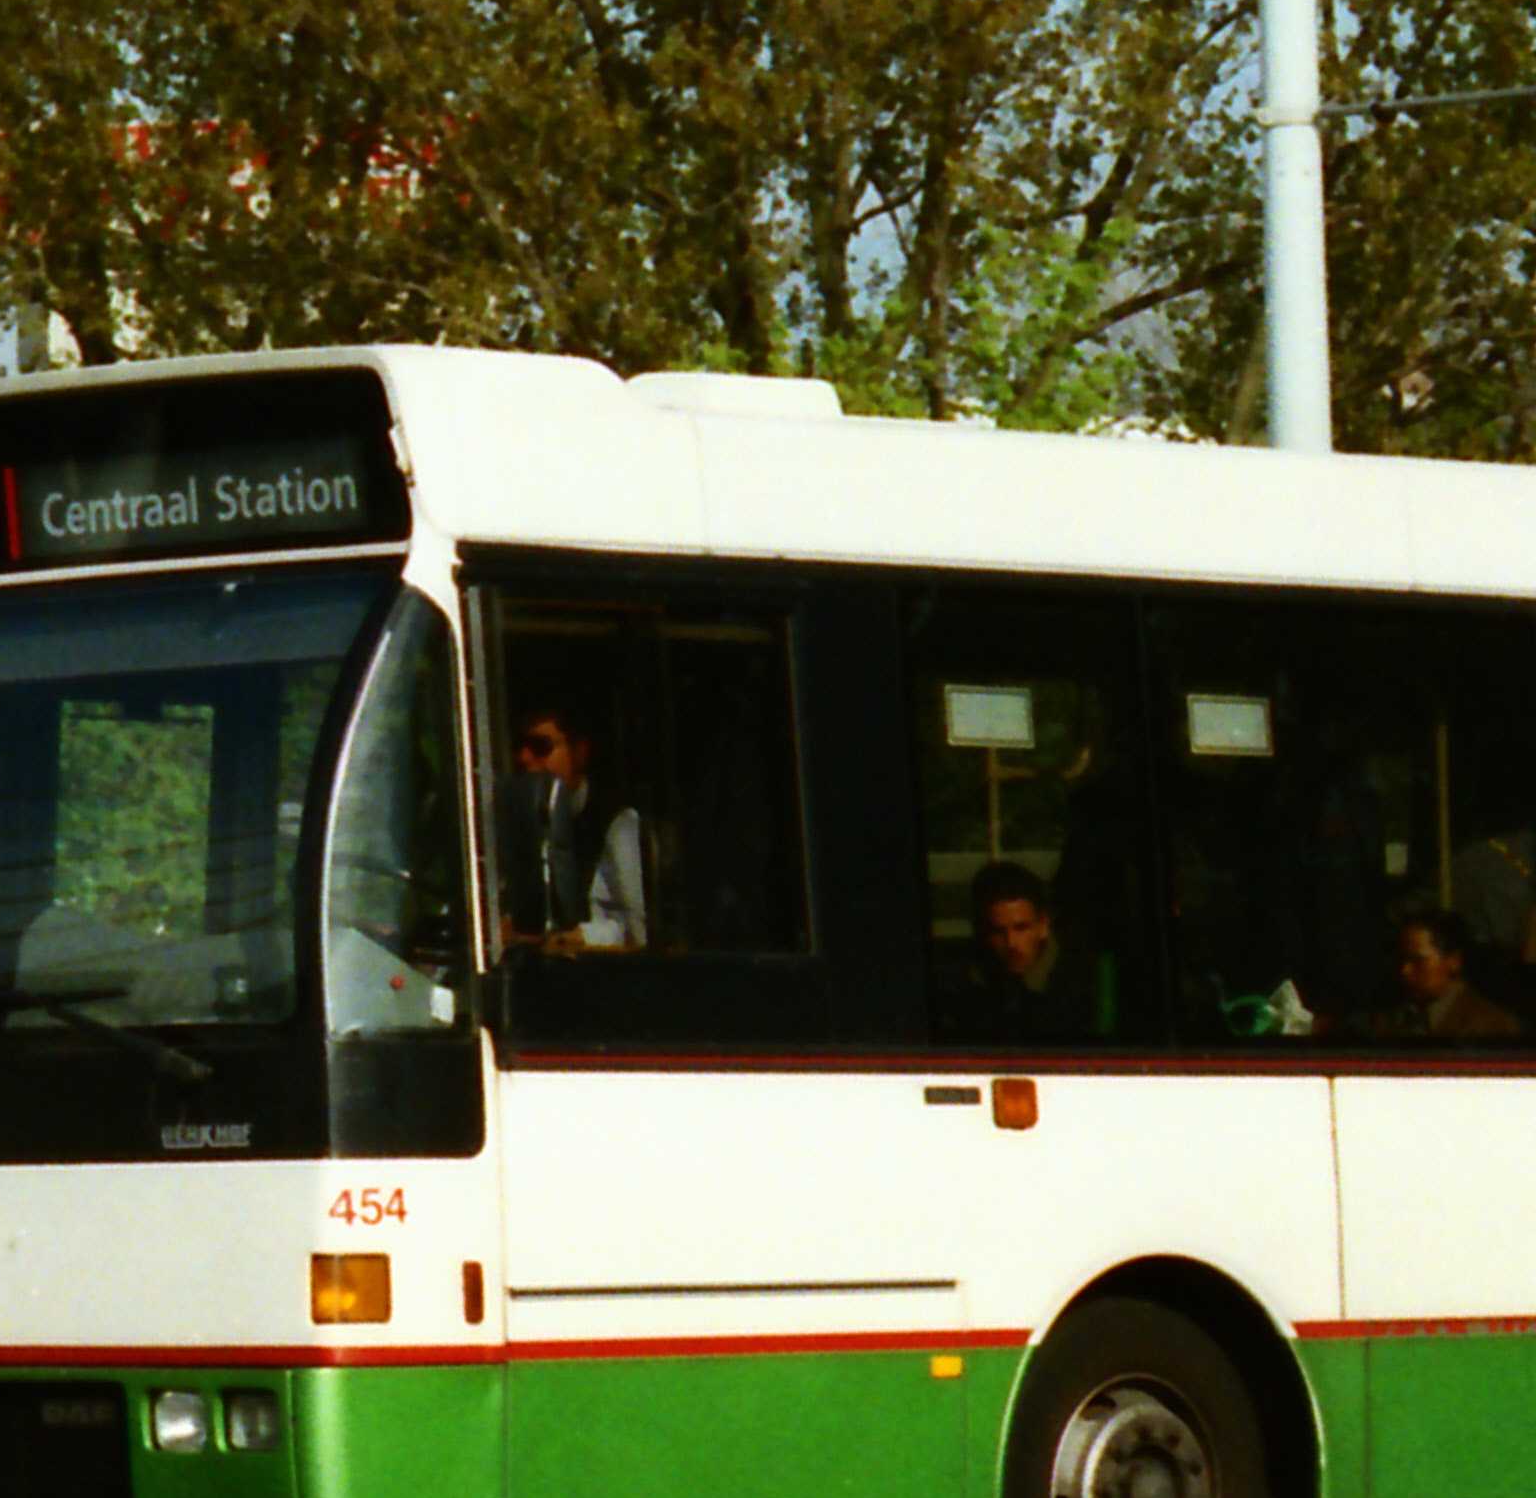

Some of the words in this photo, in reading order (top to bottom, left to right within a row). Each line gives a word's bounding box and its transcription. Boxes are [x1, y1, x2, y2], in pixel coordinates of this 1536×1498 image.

[41, 476, 199, 538] Centraal
[216, 466, 358, 522] Station
[329, 1187, 408, 1226] 454
